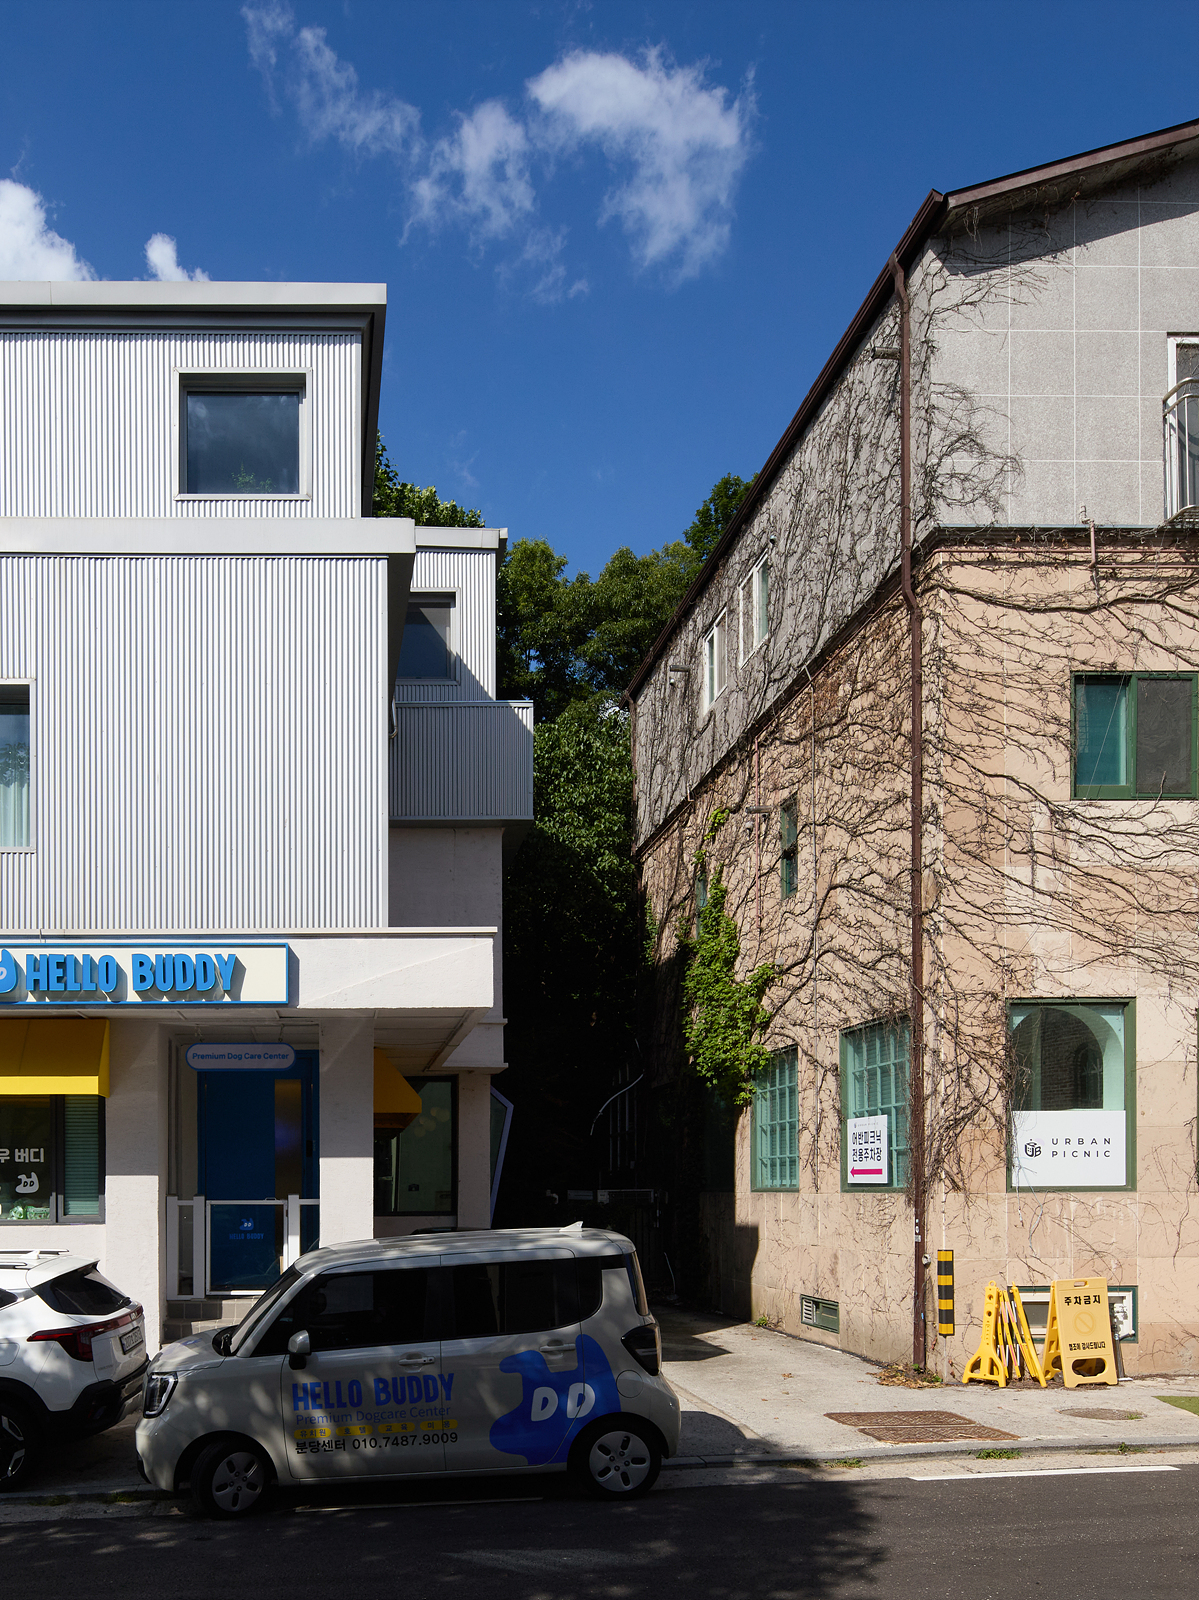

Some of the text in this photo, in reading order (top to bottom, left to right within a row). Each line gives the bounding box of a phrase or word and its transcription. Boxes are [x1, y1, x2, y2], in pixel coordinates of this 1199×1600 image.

[26, 954, 117, 993] HELLO
[132, 954, 237, 993] BUDDY
[192, 1052, 290, 1061] Premium Dog Care Center
[852, 1130, 882, 1146] 어반피크닉
[1051, 1138, 1111, 1146] URBAN
[14, 1148, 45, 1163] 버디
[852, 1147, 882, 1162] 전용주차장
[1051, 1150, 1111, 1158] PICNIC
[1064, 1294, 1101, 1306] 주차금지
[292, 1373, 455, 1411] HELLO BUDDY
[296, 1406, 452, 1425] Premium Dogcare Center
[300, 1428, 327, 1438] 유치원
[295, 1432, 458, 1454] 분당센터 010.7487.9009
